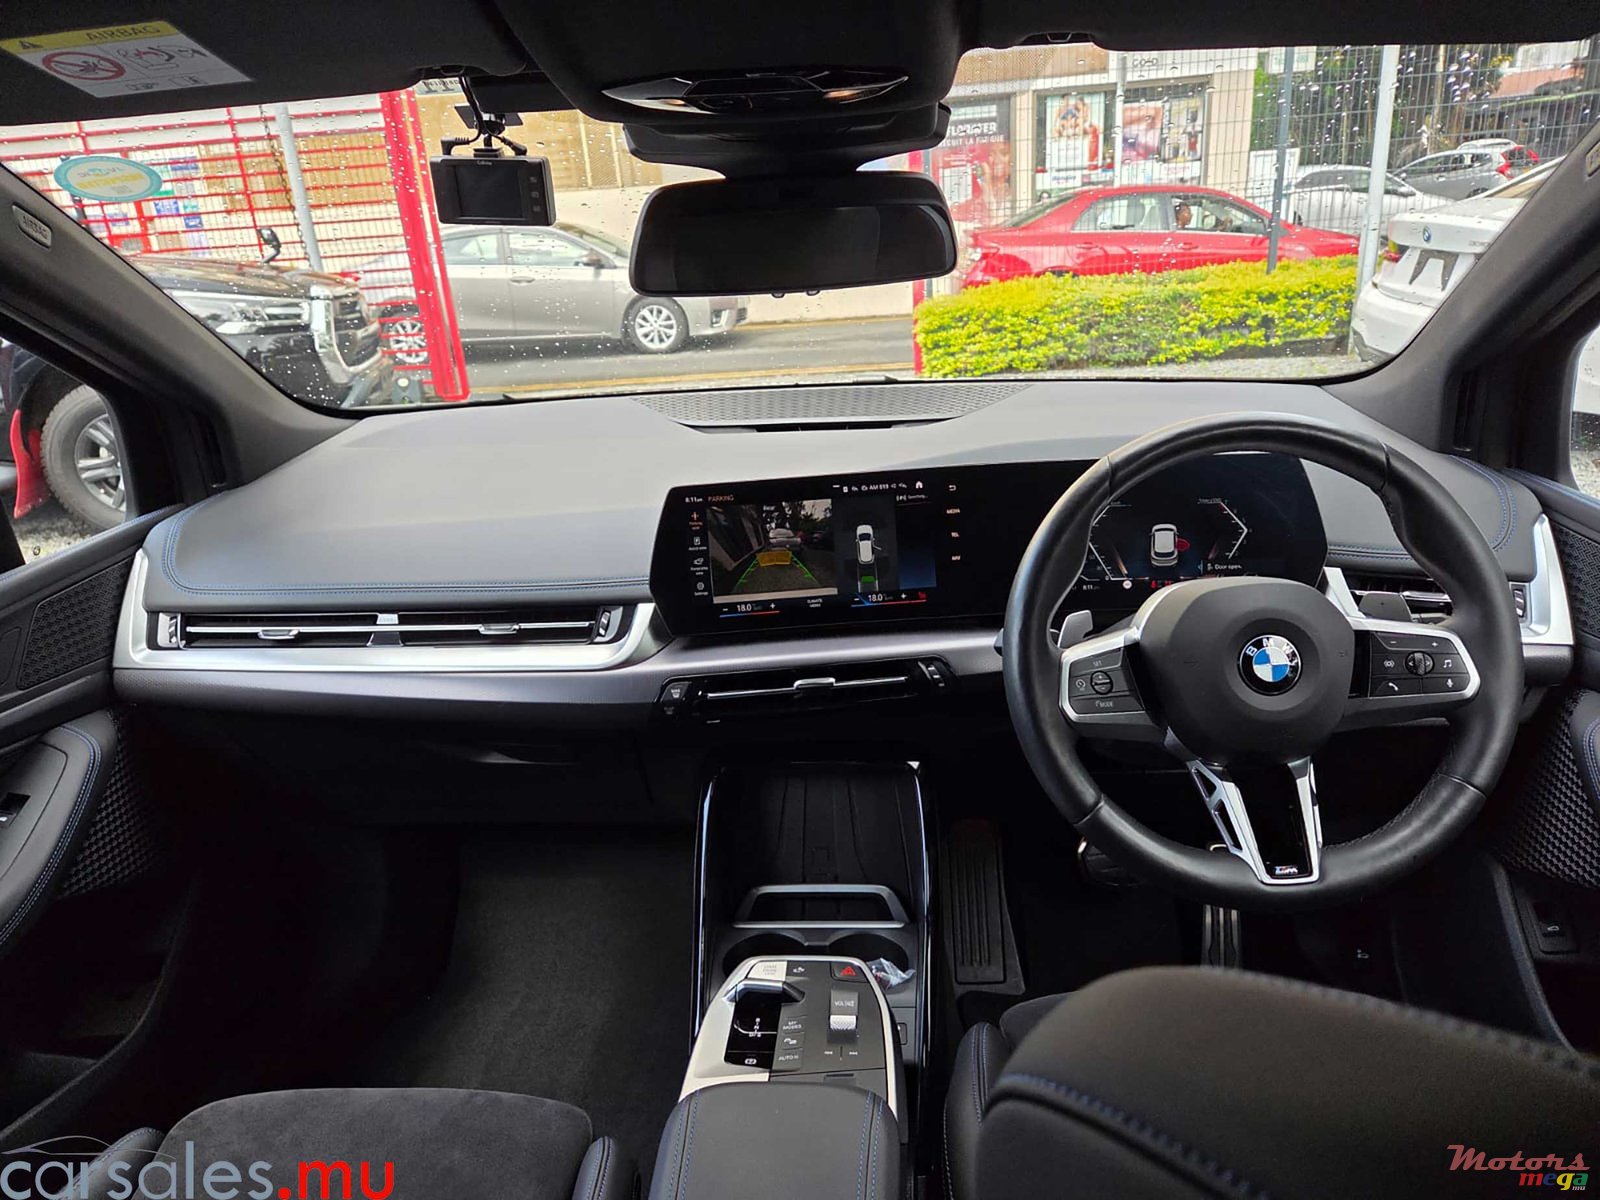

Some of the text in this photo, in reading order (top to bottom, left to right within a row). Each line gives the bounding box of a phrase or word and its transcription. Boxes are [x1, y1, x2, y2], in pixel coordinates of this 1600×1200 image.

[85, 25, 161, 42] AIRBAG
[707, 494, 735, 502] PARKING
[737, 603, 752, 612] 18.0
